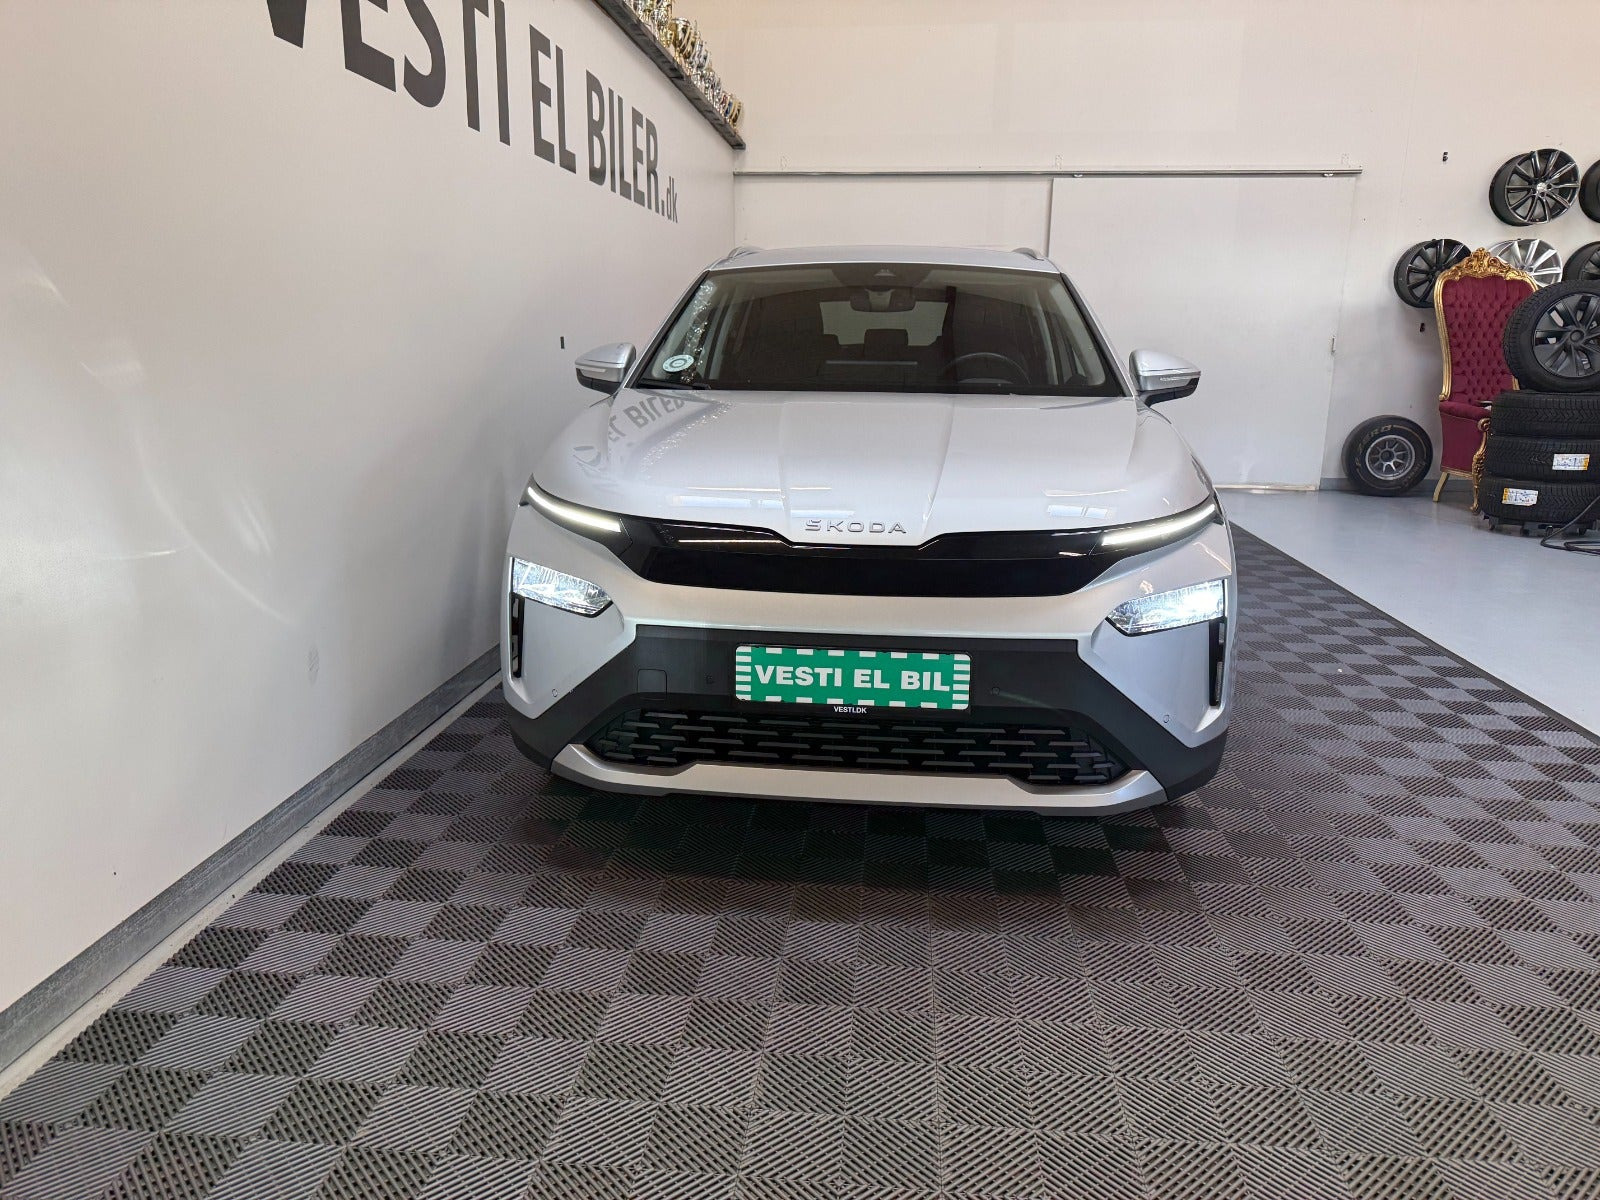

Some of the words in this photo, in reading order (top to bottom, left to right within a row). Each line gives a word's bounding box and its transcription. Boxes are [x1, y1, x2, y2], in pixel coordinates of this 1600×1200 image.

[267, 0, 511, 147] STI
[529, 24, 577, 174] EL
[586, 69, 678, 224] BILER.dk
[804, 519, 907, 534] ŠKODA
[754, 664, 843, 688] VESTI
[853, 669, 890, 690] EL
[900, 670, 950, 692] BIL
